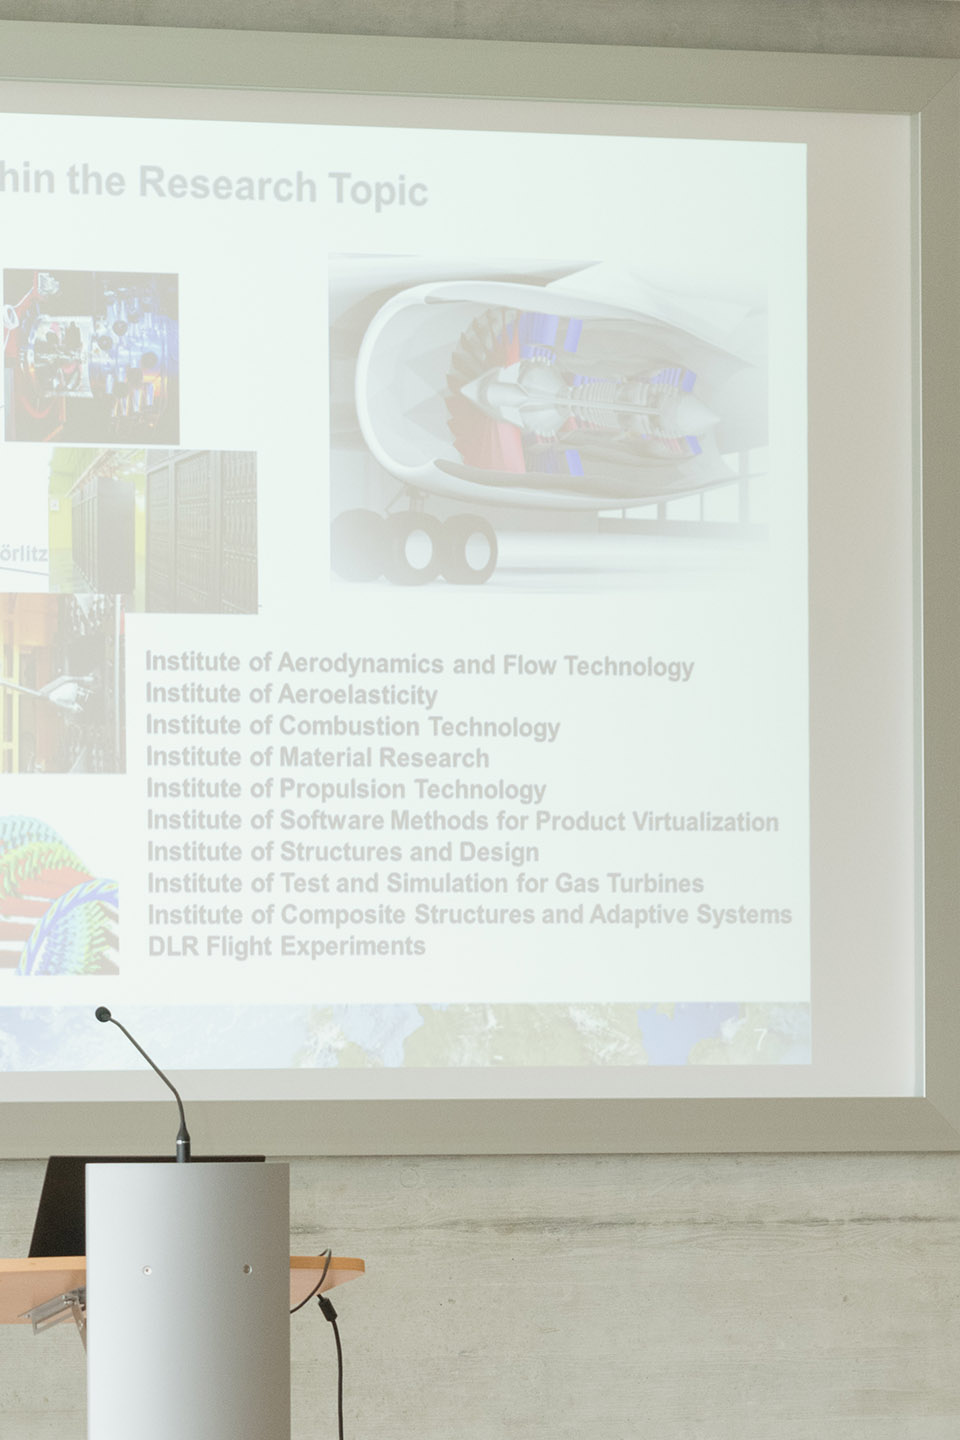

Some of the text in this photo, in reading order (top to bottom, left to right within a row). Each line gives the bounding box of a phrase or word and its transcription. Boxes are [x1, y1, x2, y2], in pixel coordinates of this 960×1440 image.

[66, 162, 126, 197] the
[139, 164, 317, 203] Research
[327, 171, 429, 214] Topic
[145, 649, 695, 683] Institute of Aerodynamics and Flow Technology
[146, 681, 438, 711] Institute of Aeroelasticity
[146, 713, 561, 743] Institute of Combustion Technology
[146, 744, 490, 769] Institute of Material Research
[146, 776, 547, 805] Institute of Propulsion Technology
[147, 808, 779, 833] Institute of Software Methods for Product Virtualization
[147, 840, 540, 868] Institute of Structures and Design
[148, 871, 705, 894] Institute of Test and Simulation for Gas Turbines
[148, 903, 793, 930] Institute of Composite Structures and Adaptive Systems
[148, 934, 426, 962] DLR Flight Experiments
[753, 1028, 768, 1051] 7
